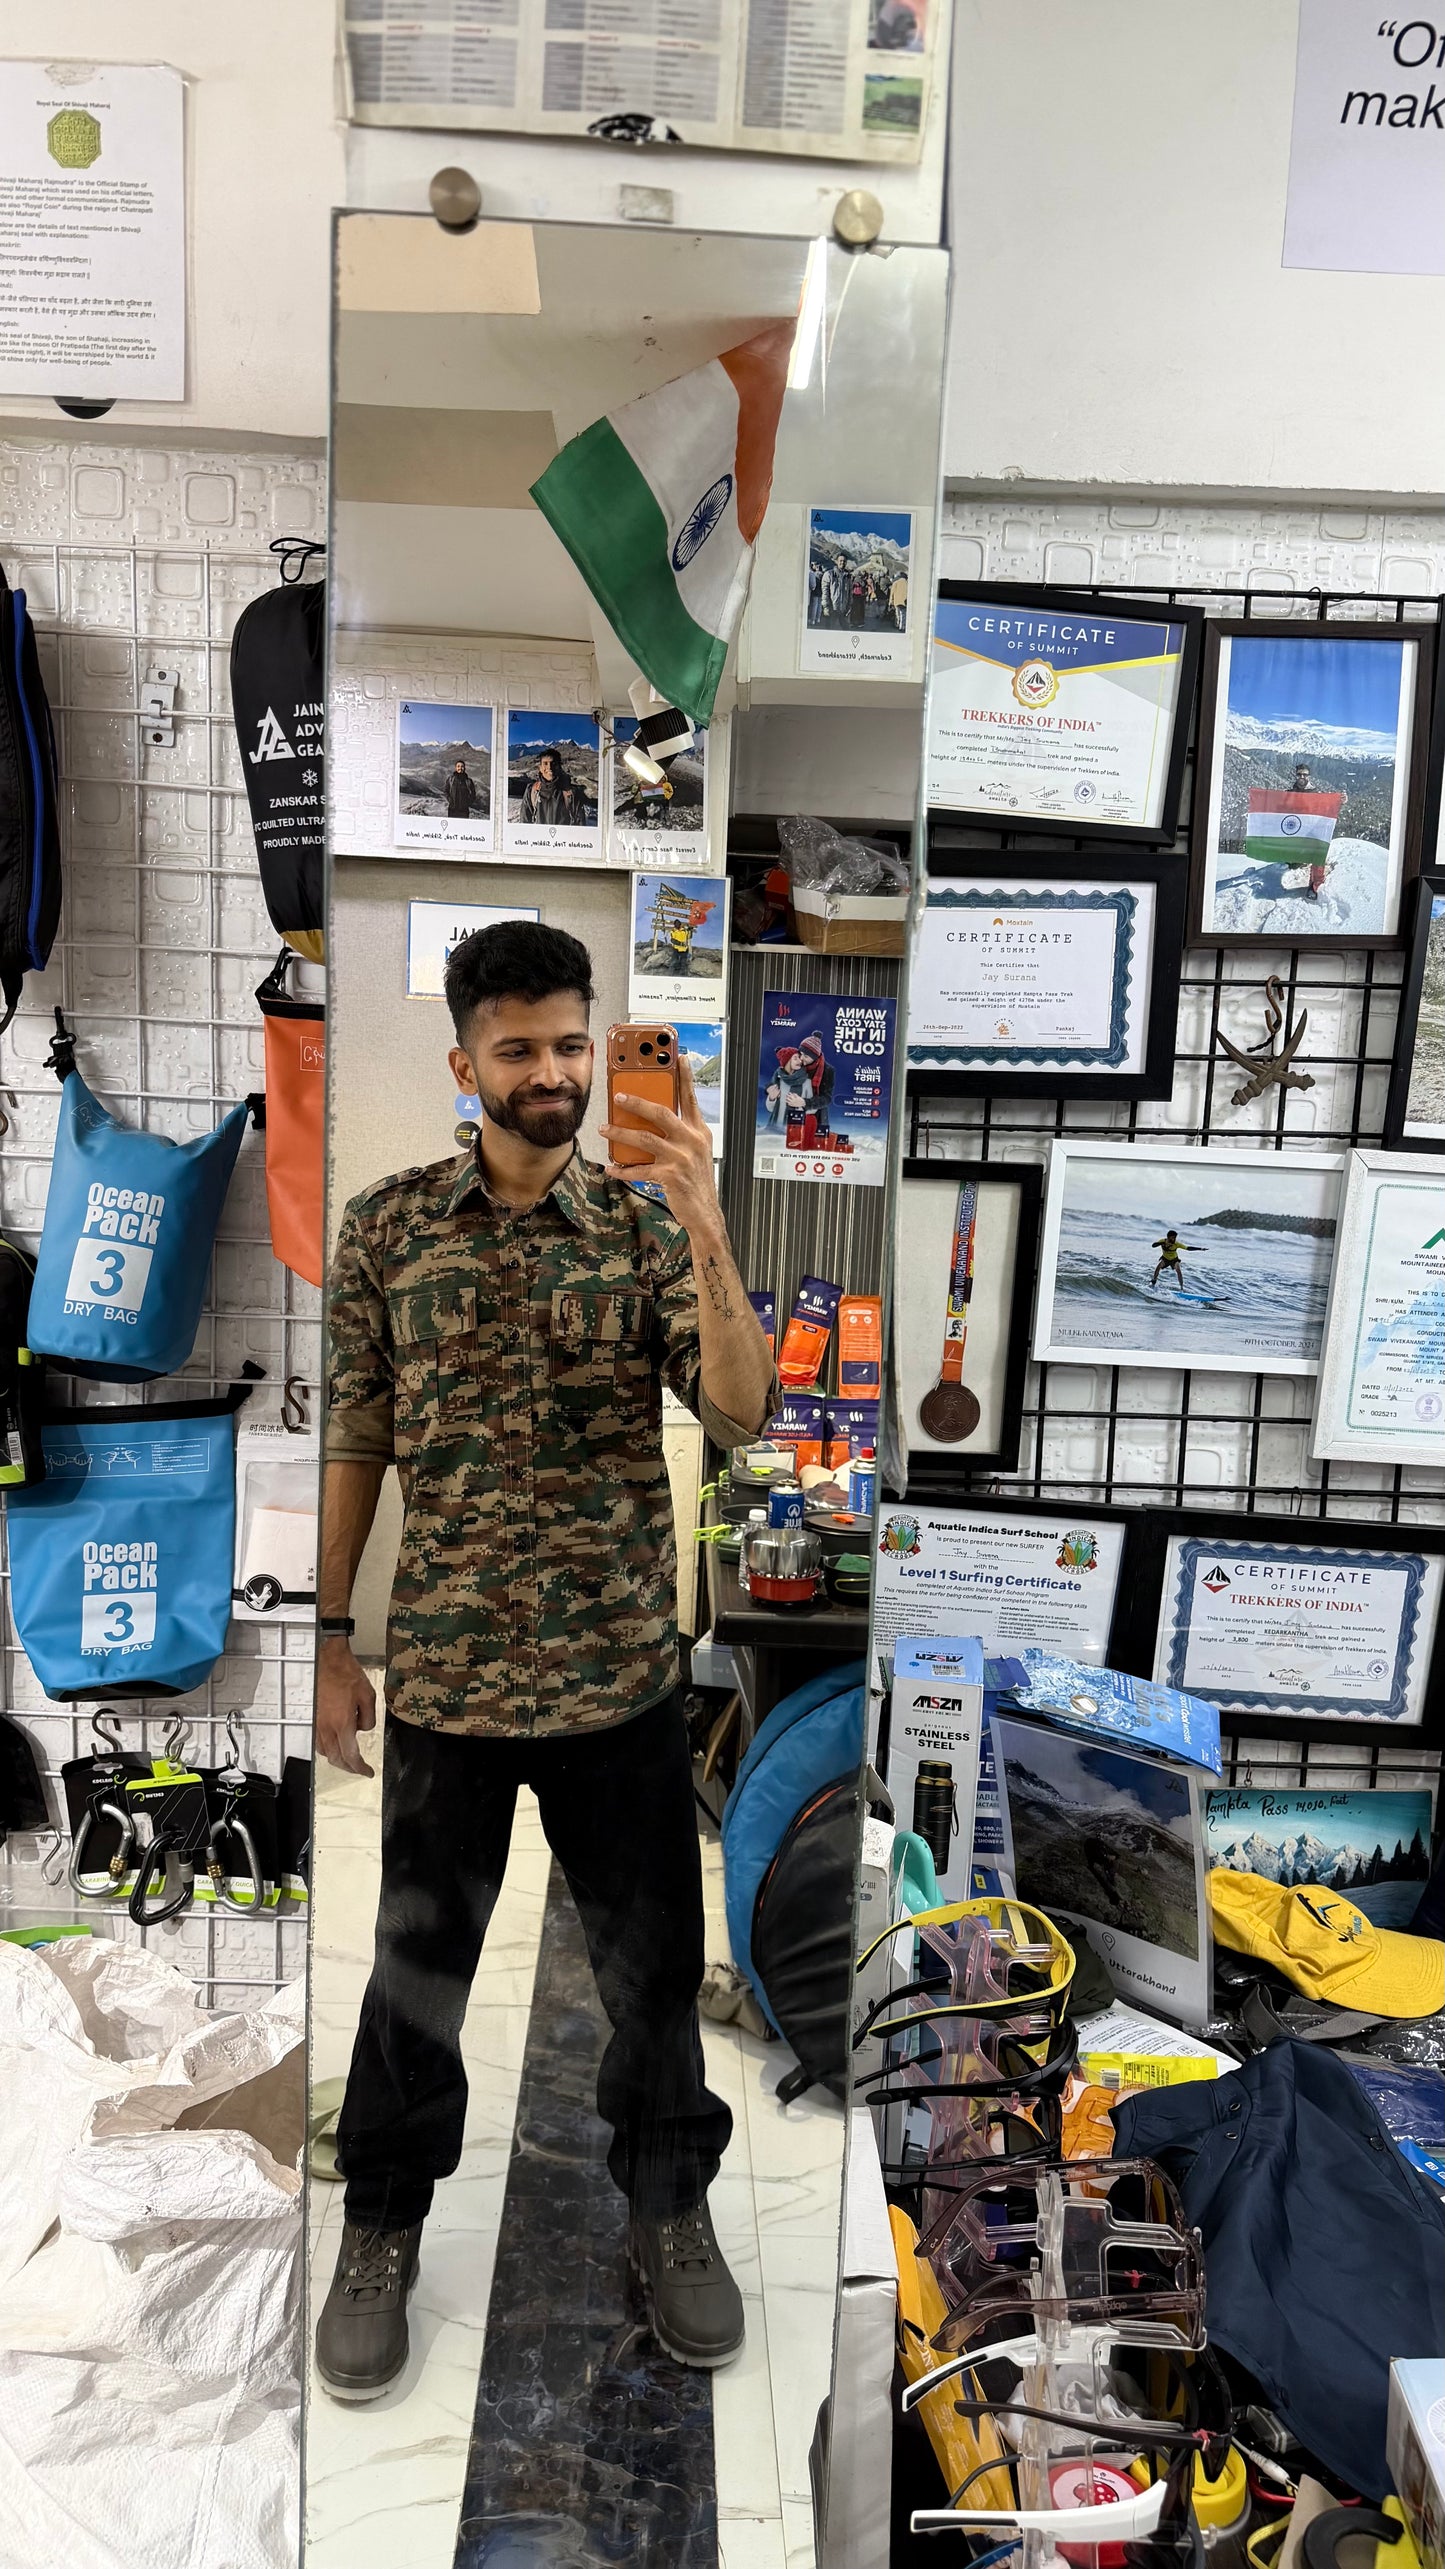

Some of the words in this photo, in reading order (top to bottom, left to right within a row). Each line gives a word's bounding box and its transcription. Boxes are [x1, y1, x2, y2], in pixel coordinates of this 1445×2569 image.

[969, 618, 1115, 644] CERTIFICATE
[1007, 641, 1023, 649] OF
[1030, 643, 1078, 655] SUMMIT
[293, 704, 324, 717] JAIN
[962, 710, 1034, 726] TREKKERS
[1037, 717, 1055, 728] OF
[296, 724, 324, 737] ADV
[297, 744, 324, 757] GEA
[270, 796, 317, 808] ZANSKAR
[262, 818, 294, 830] QUILTED
[297, 817, 326, 826] ULTRA
[264, 837, 299, 849] PROUDLY
[302, 835, 326, 845] MADE
[946, 933, 1072, 943] CERTIFICATE
[982, 974, 999, 982] Jay
[88, 1182, 165, 1216] Ocean
[964, 1189, 974, 1200] OF
[82, 1206, 159, 1245] Pack
[960, 1200, 974, 1238] INSTITUTE
[956, 1240, 969, 1286] VIVEKANAND
[89, 1250, 128, 1297] 3
[952, 1287, 964, 1312] SWAMI
[64, 1302, 95, 1318] DRY
[103, 1307, 138, 1325] BAG
[1082, 1331, 1124, 1339] KARNATAKA
[928, 1522, 967, 1531] Aquatic
[968, 1525, 999, 1534] Indica
[1000, 1528, 1024, 1536] Surf
[1024, 1530, 1058, 1539] School
[84, 1542, 157, 1562] Ocean
[84, 1562, 157, 1590] Pack
[900, 1566, 936, 1578] Level
[940, 1570, 946, 1579] 1
[949, 1571, 1003, 1587] Surfing
[1005, 1576, 1081, 1590] Certificate
[1234, 1565, 1371, 1584] CERTIFICATE
[1291, 1585, 1338, 1594] SUMMIT
[1229, 1595, 1301, 1607] TREKKERS
[1305, 1600, 1323, 1609] OF
[104, 1600, 134, 1641] 3
[81, 1646, 109, 1656] DRY
[121, 1641, 153, 1655] BAG
[905, 1728, 969, 1741] STAINLESS
[918, 1739, 955, 1750] STEEL
[1261, 1796, 1290, 1816] Pass
[1108, 1958, 1176, 1996] Uttarakhand
